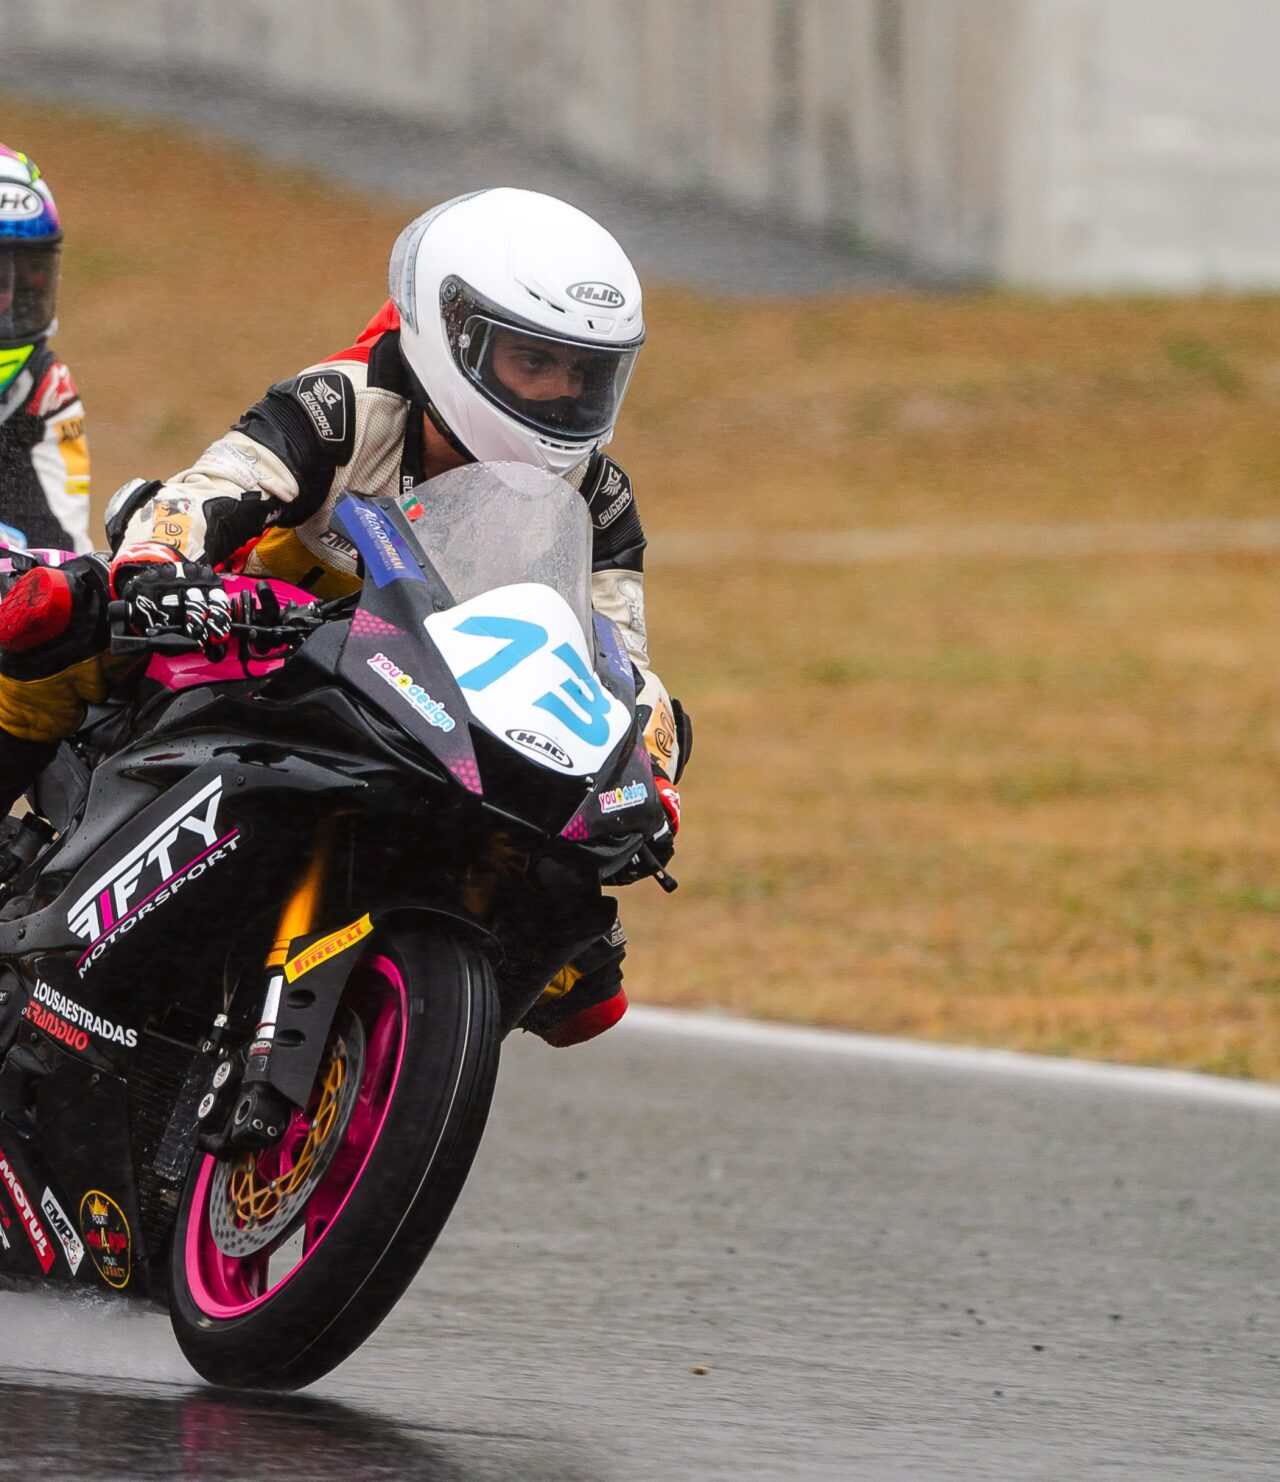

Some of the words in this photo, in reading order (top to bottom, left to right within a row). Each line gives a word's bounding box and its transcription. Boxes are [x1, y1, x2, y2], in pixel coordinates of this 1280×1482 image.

[574, 285, 621, 305] HJC
[453, 615, 612, 747] 73
[517, 732, 566, 761] HJC
[77, 834, 241, 980] MOTORSPORT
[294, 922, 365, 974] PIRELLI
[33, 978, 139, 1048] LOUSAESTRADAS
